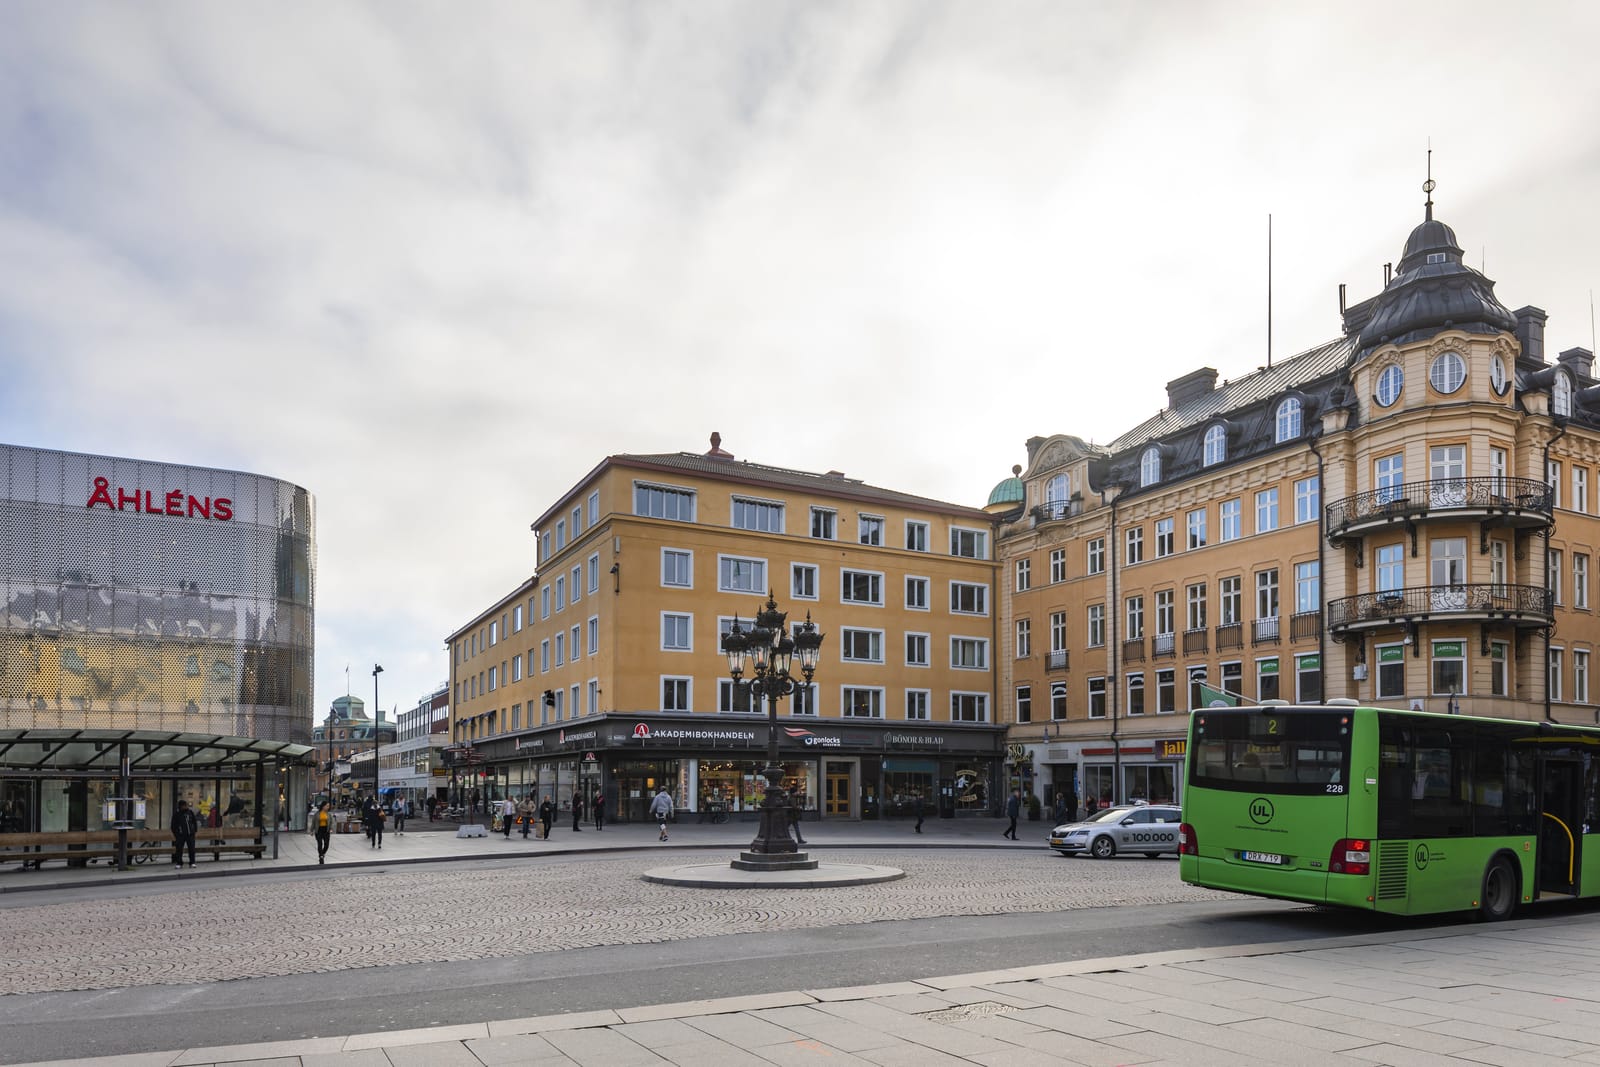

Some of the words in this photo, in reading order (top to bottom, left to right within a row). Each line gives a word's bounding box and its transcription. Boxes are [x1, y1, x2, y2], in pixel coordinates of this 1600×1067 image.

[87, 476, 234, 521] ÅHLÉNS
[1269, 719, 1277, 734] 2
[654, 730, 755, 740] AKADEMIBOKHANDELN
[1326, 784, 1344, 793] 228
[1253, 805, 1270, 817] UL
[1417, 851, 1426, 862] UL
